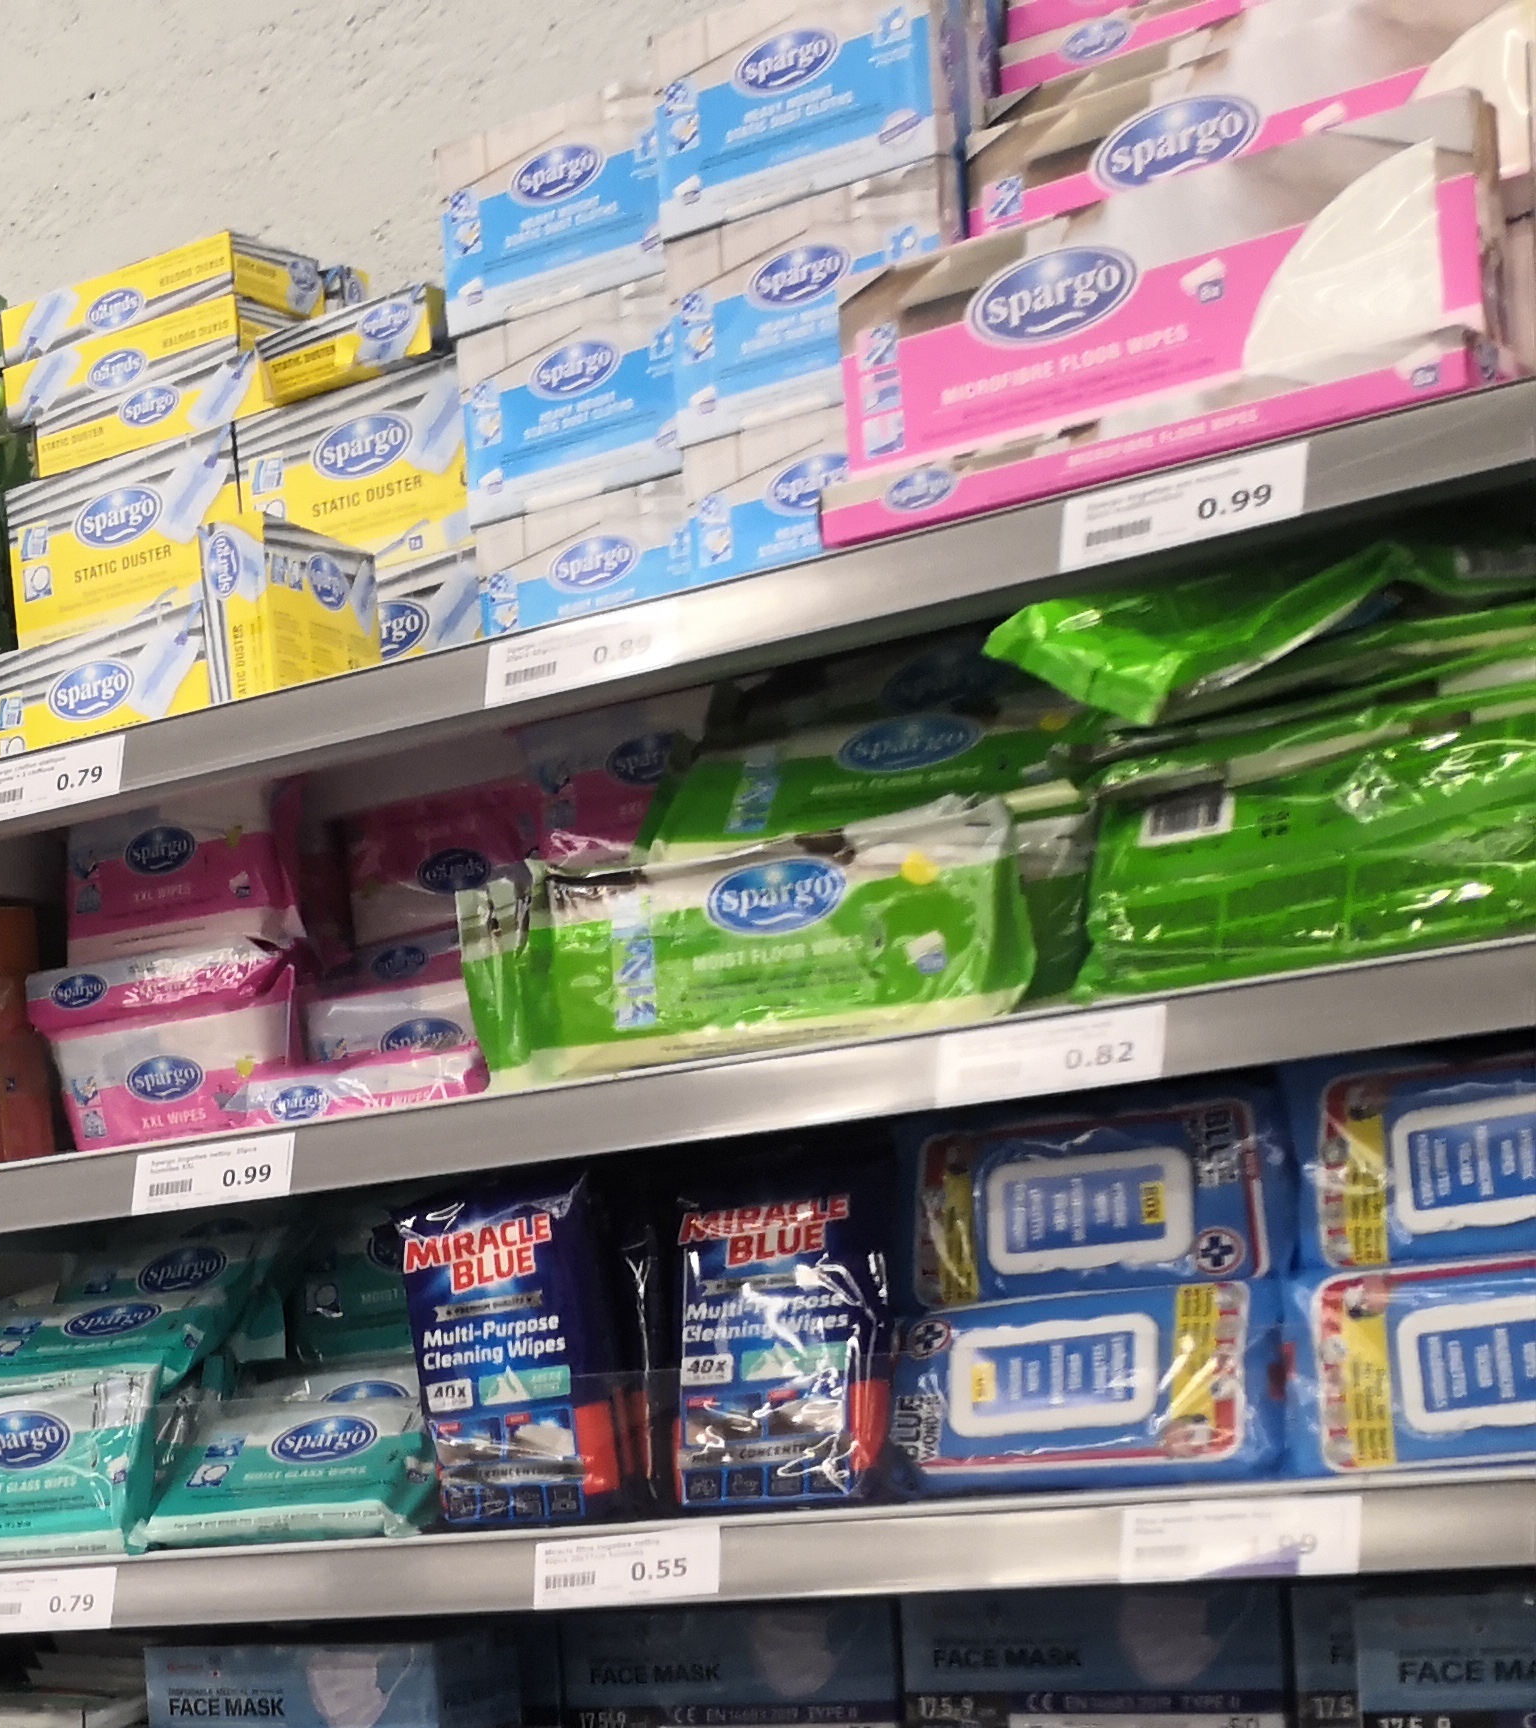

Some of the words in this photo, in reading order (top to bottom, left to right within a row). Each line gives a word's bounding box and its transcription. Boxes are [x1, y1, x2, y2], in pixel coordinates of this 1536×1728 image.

[743, 35, 830, 87] spargo
[1099, 105, 1246, 187] spargo
[518, 151, 599, 197] spargo
[755, 251, 841, 299] spargo
[979, 259, 1126, 335] spargo
[537, 346, 615, 389] spargo
[1059, 342, 1120, 376] FLOOR
[1126, 325, 1188, 360] WIPES
[123, 390, 176, 423] spargo
[321, 423, 406, 471] spargo
[82, 493, 157, 540] spargo
[311, 494, 362, 519] STATIC
[366, 475, 423, 506] DUSTER
[1198, 484, 1273, 523] 0.99
[73, 560, 119, 584] STATIC
[122, 544, 172, 571] DUSTER
[556, 542, 631, 582] spargo
[54, 666, 128, 716] spargo
[57, 765, 103, 791] 0.79
[131, 829, 192, 870] spargo
[718, 863, 840, 921] spargo
[751, 942, 805, 966] FLOOR
[54, 978, 106, 1008] spargo
[1065, 1040, 1136, 1070] 0.82
[134, 1061, 198, 1098] spargo
[141, 1112, 168, 1131] XXL
[170, 1107, 206, 1127] WIPES
[223, 1164, 271, 1187] 0.99
[678, 1194, 850, 1245] MIRACLE
[404, 1212, 552, 1273] MIRACLE
[726, 1221, 827, 1266] BLUE
[142, 1253, 222, 1287] spargo
[451, 1247, 536, 1294] BLUE
[68, 1304, 159, 1336] spargo
[423, 1313, 559, 1349] Multi-Purpose
[423, 1339, 503, 1371] Cleaning
[507, 1335, 566, 1360] Wipes
[433, 1384, 466, 1399] 40x
[276, 1422, 372, 1458] spargo
[631, 1557, 687, 1581] 0.55
[49, 1594, 95, 1614] 0.79
[169, 1698, 220, 1716] FACE
[227, 1698, 285, 1716] MASK
